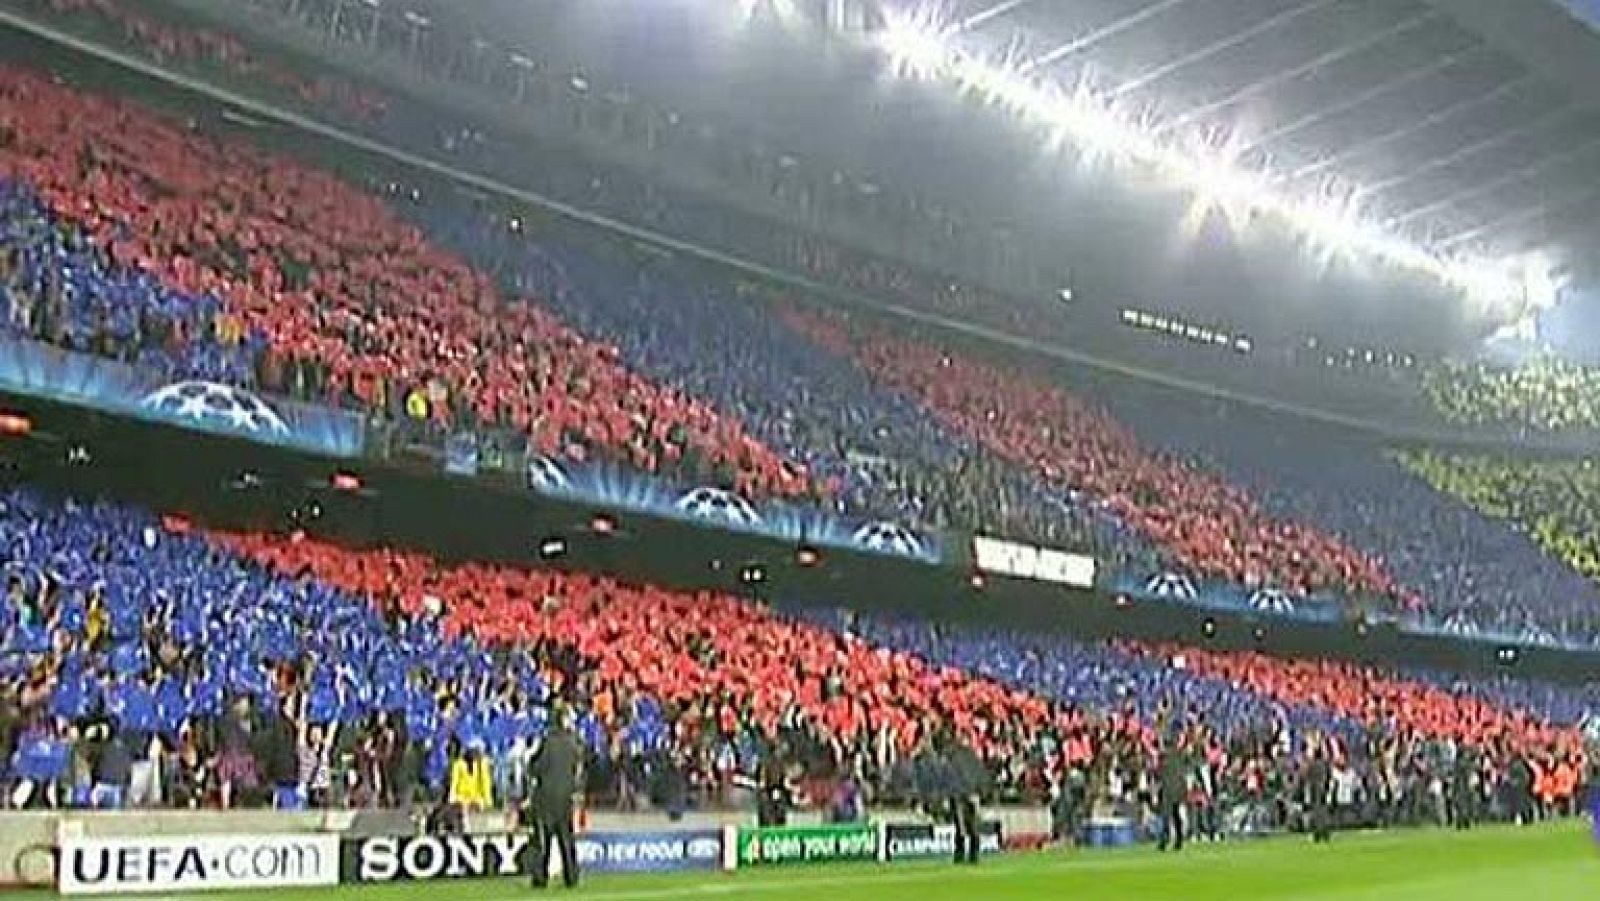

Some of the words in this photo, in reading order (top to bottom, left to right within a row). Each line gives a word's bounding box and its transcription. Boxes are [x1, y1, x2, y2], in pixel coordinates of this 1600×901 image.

[361, 837, 529, 880] SONY
[764, 834, 800, 861] open
[804, 834, 835, 860] your
[839, 831, 875, 854] world
